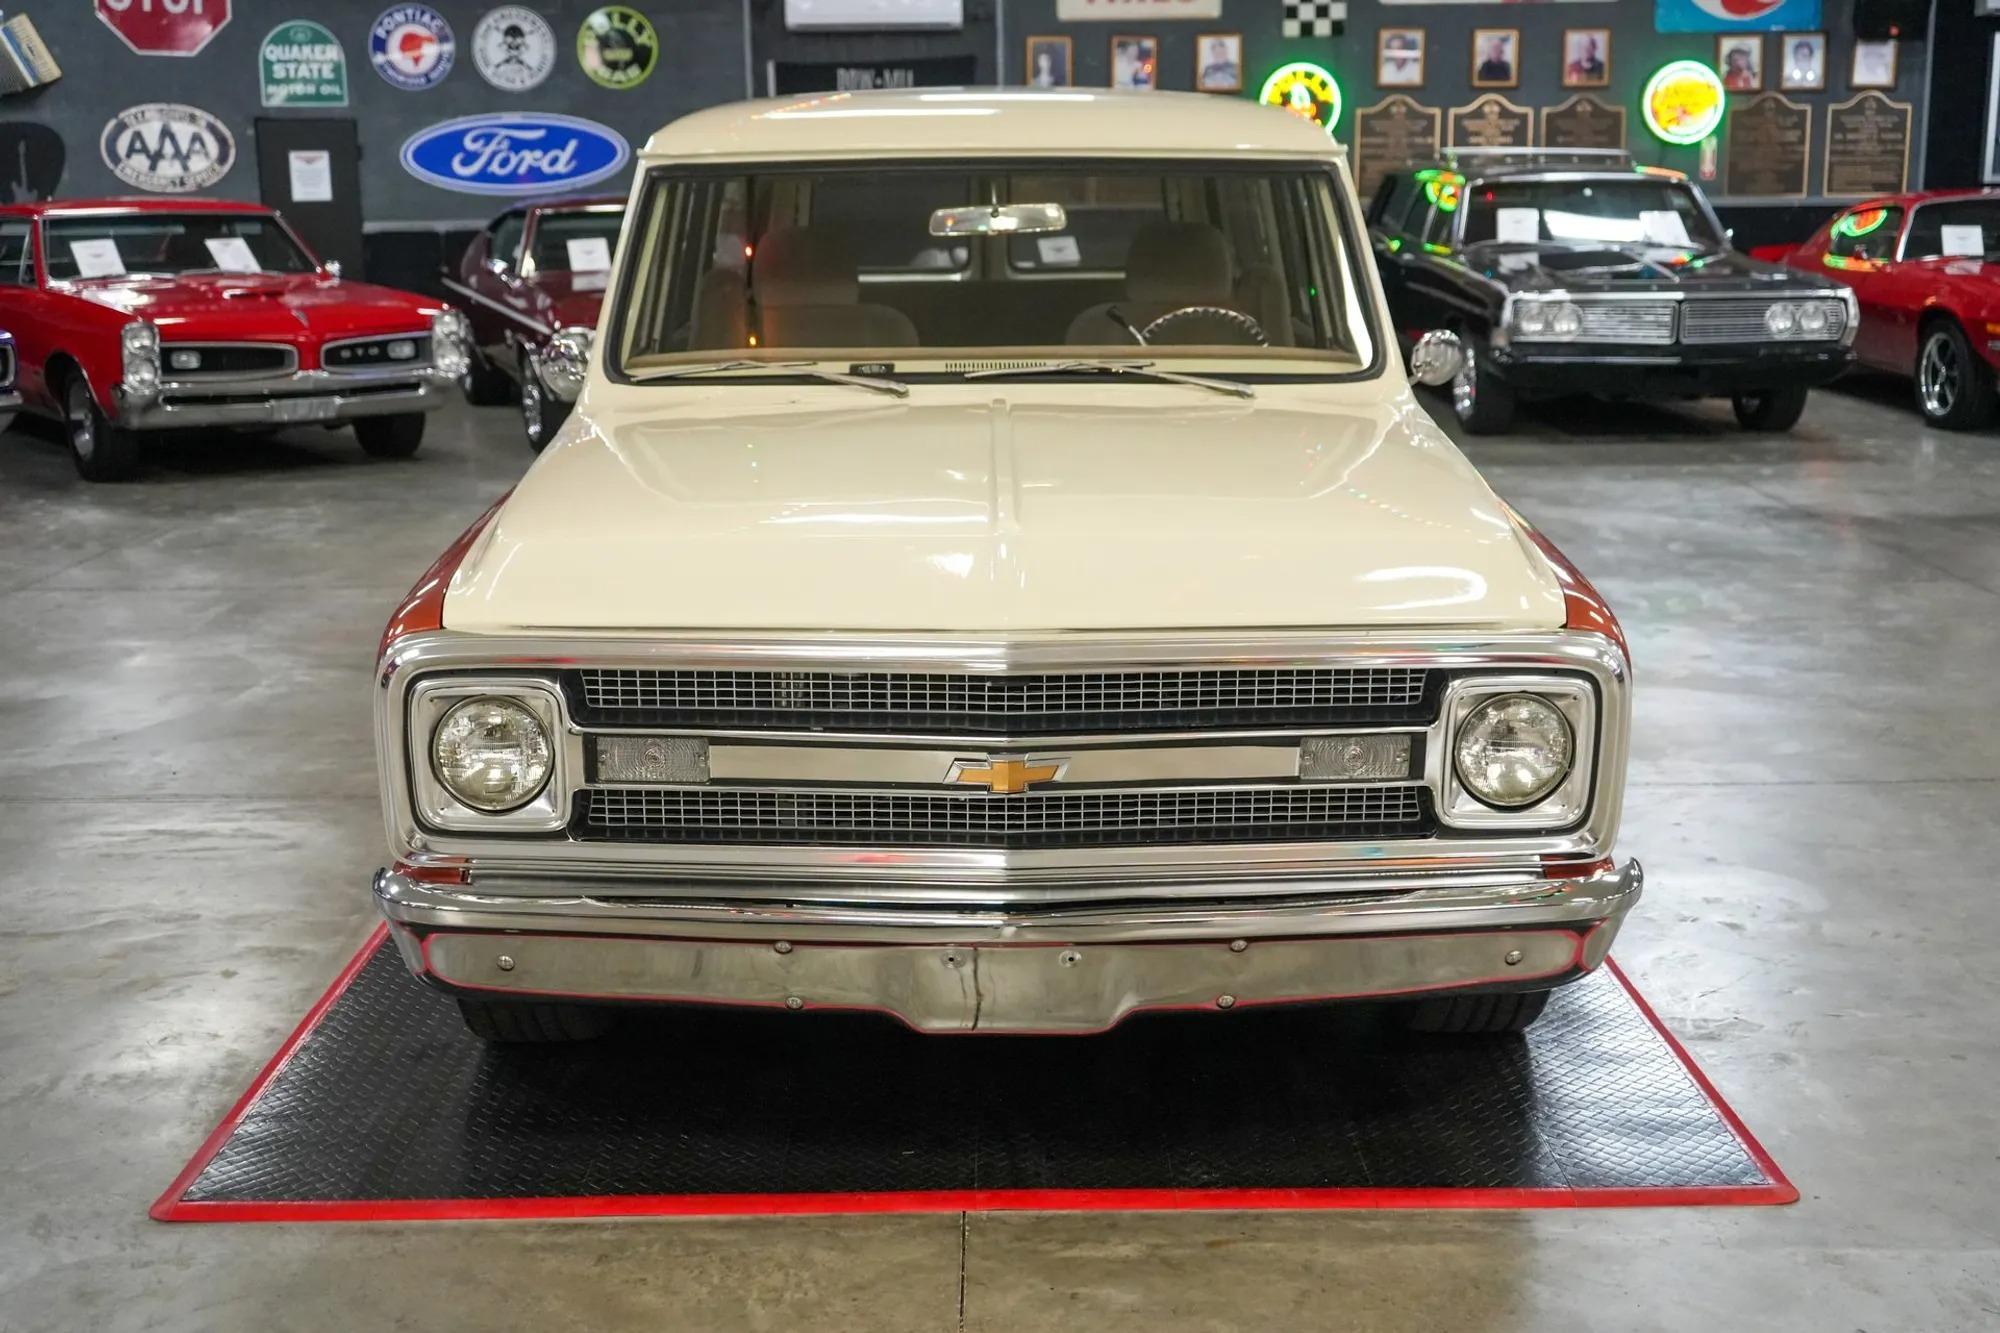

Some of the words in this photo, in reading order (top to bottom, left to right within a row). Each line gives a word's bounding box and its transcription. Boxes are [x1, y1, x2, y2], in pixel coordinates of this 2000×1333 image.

[375, 8, 444, 39] PONTIAC
[265, 43, 341, 62] QUAKER
[272, 62, 335, 79] STATE
[266, 83, 316, 96] MOTOR
[319, 83, 342, 96] OIL
[125, 121, 210, 172] AAA
[452, 127, 578, 176] Ford
